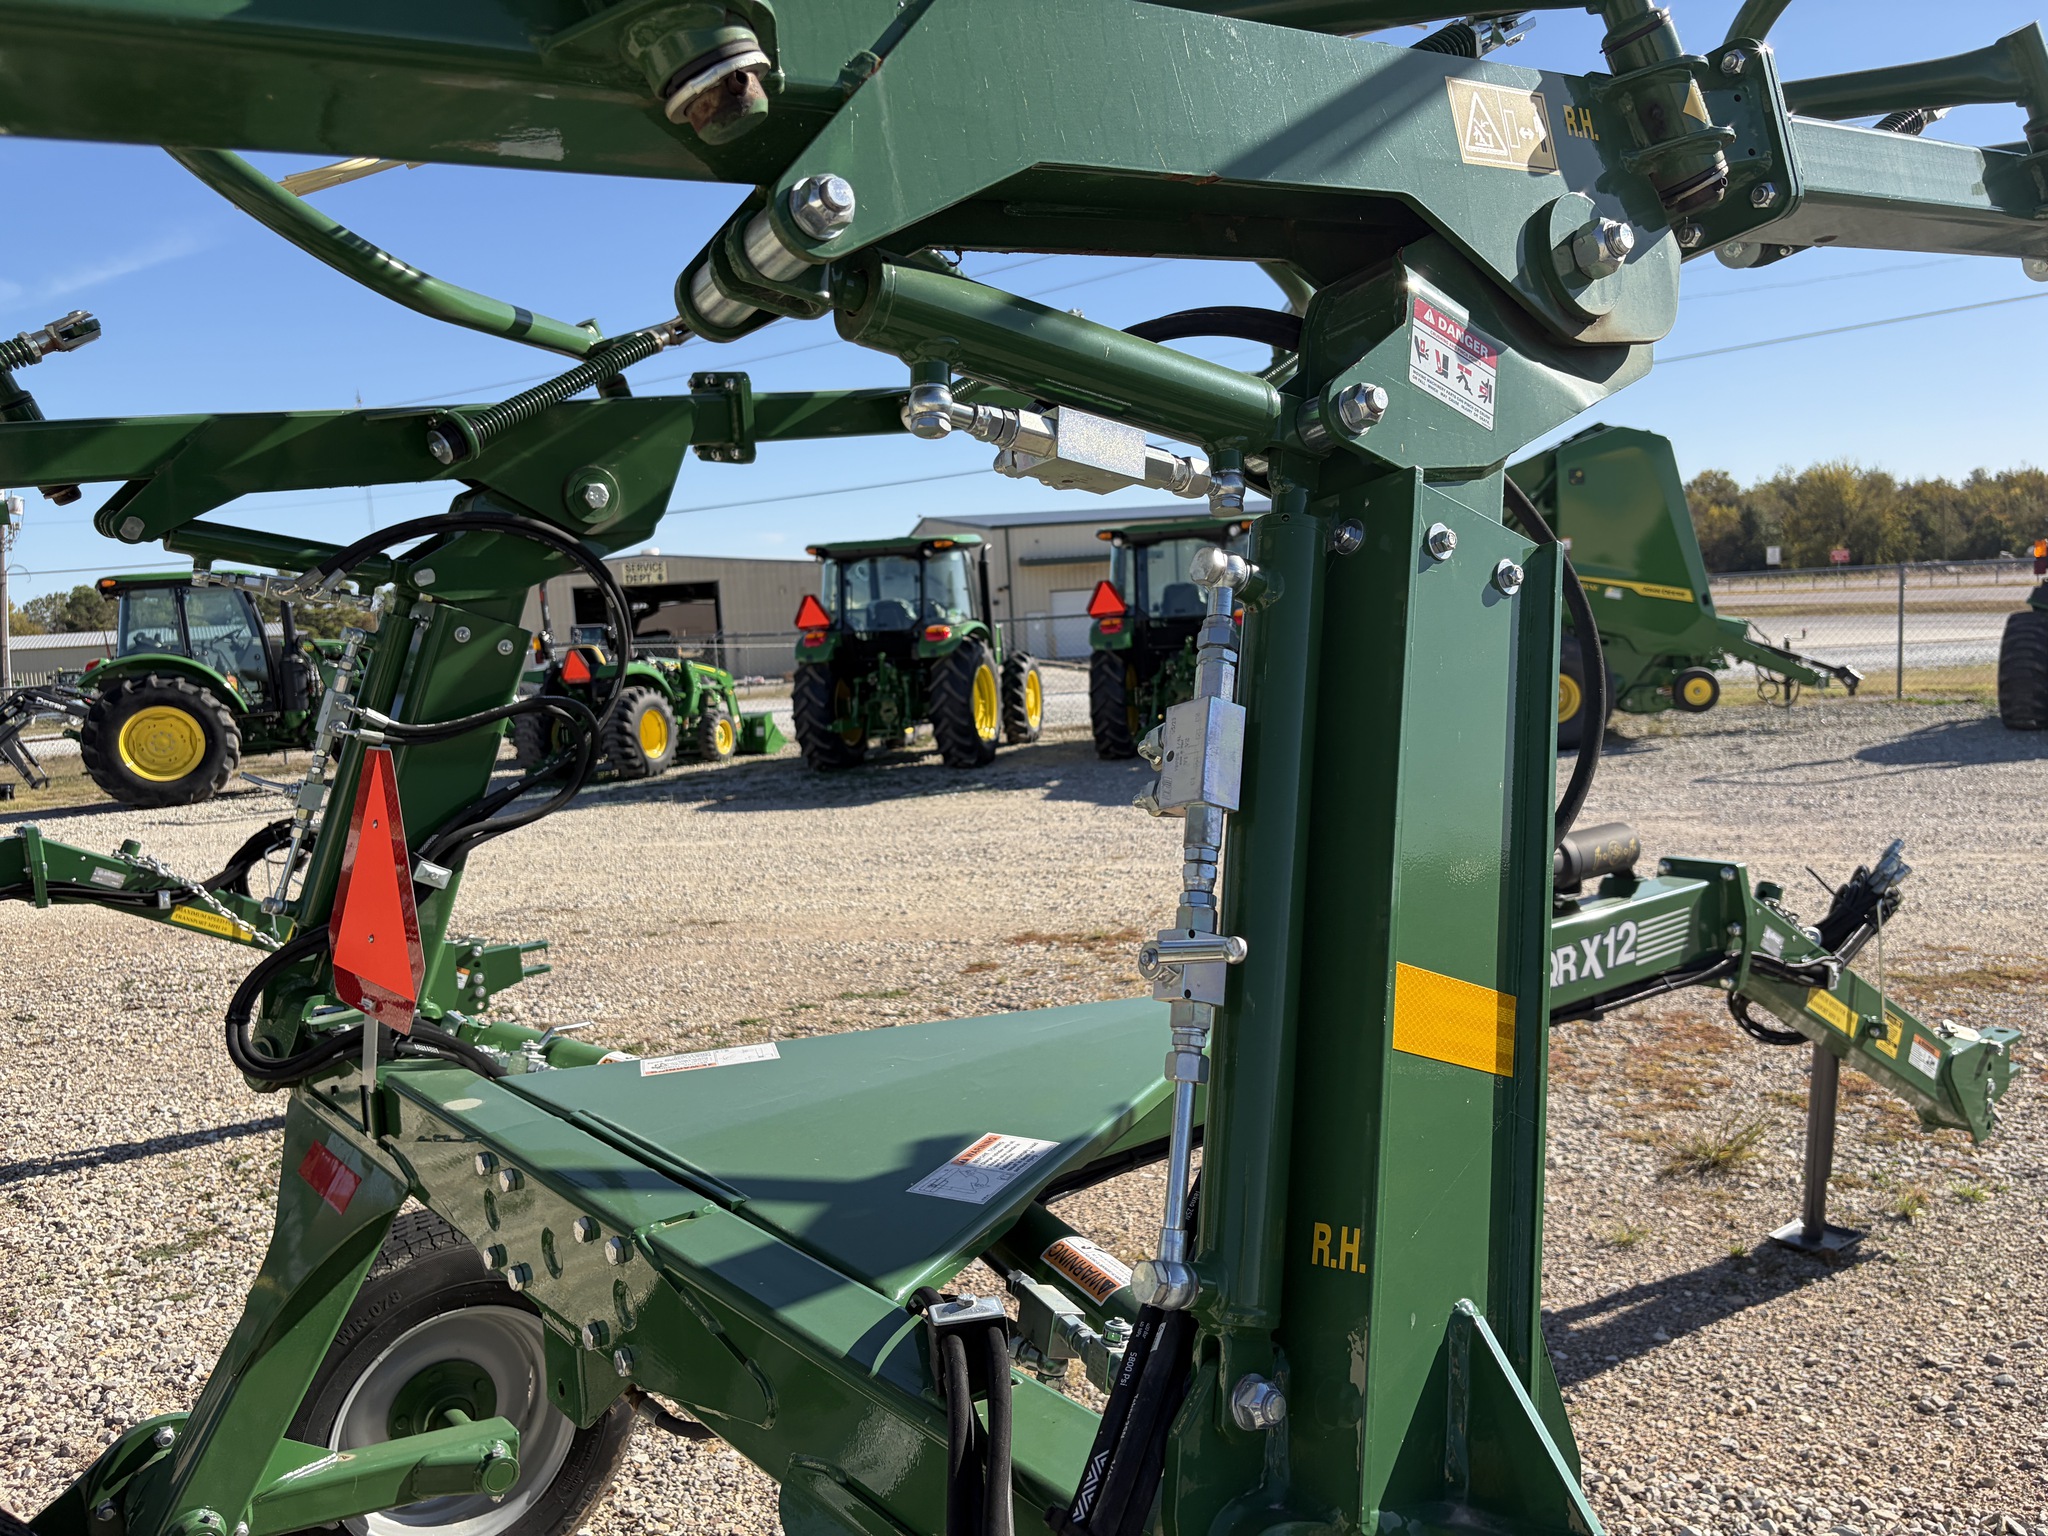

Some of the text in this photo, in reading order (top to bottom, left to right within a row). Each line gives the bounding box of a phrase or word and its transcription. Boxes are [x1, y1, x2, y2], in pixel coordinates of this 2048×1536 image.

[1562, 104, 1600, 141] R.H.
[1438, 316, 1488, 359] DANGER
[1427, 377, 1445, 392] MACHINERY
[1446, 389, 1456, 399] PARTS
[625, 561, 663, 572] SERVICE
[966, 1136, 998, 1157] WARNING
[1311, 1221, 1367, 1274] R.H.
[1048, 1243, 1107, 1296] WARNING
[1118, 1350, 1138, 1387] 5800 Psi
